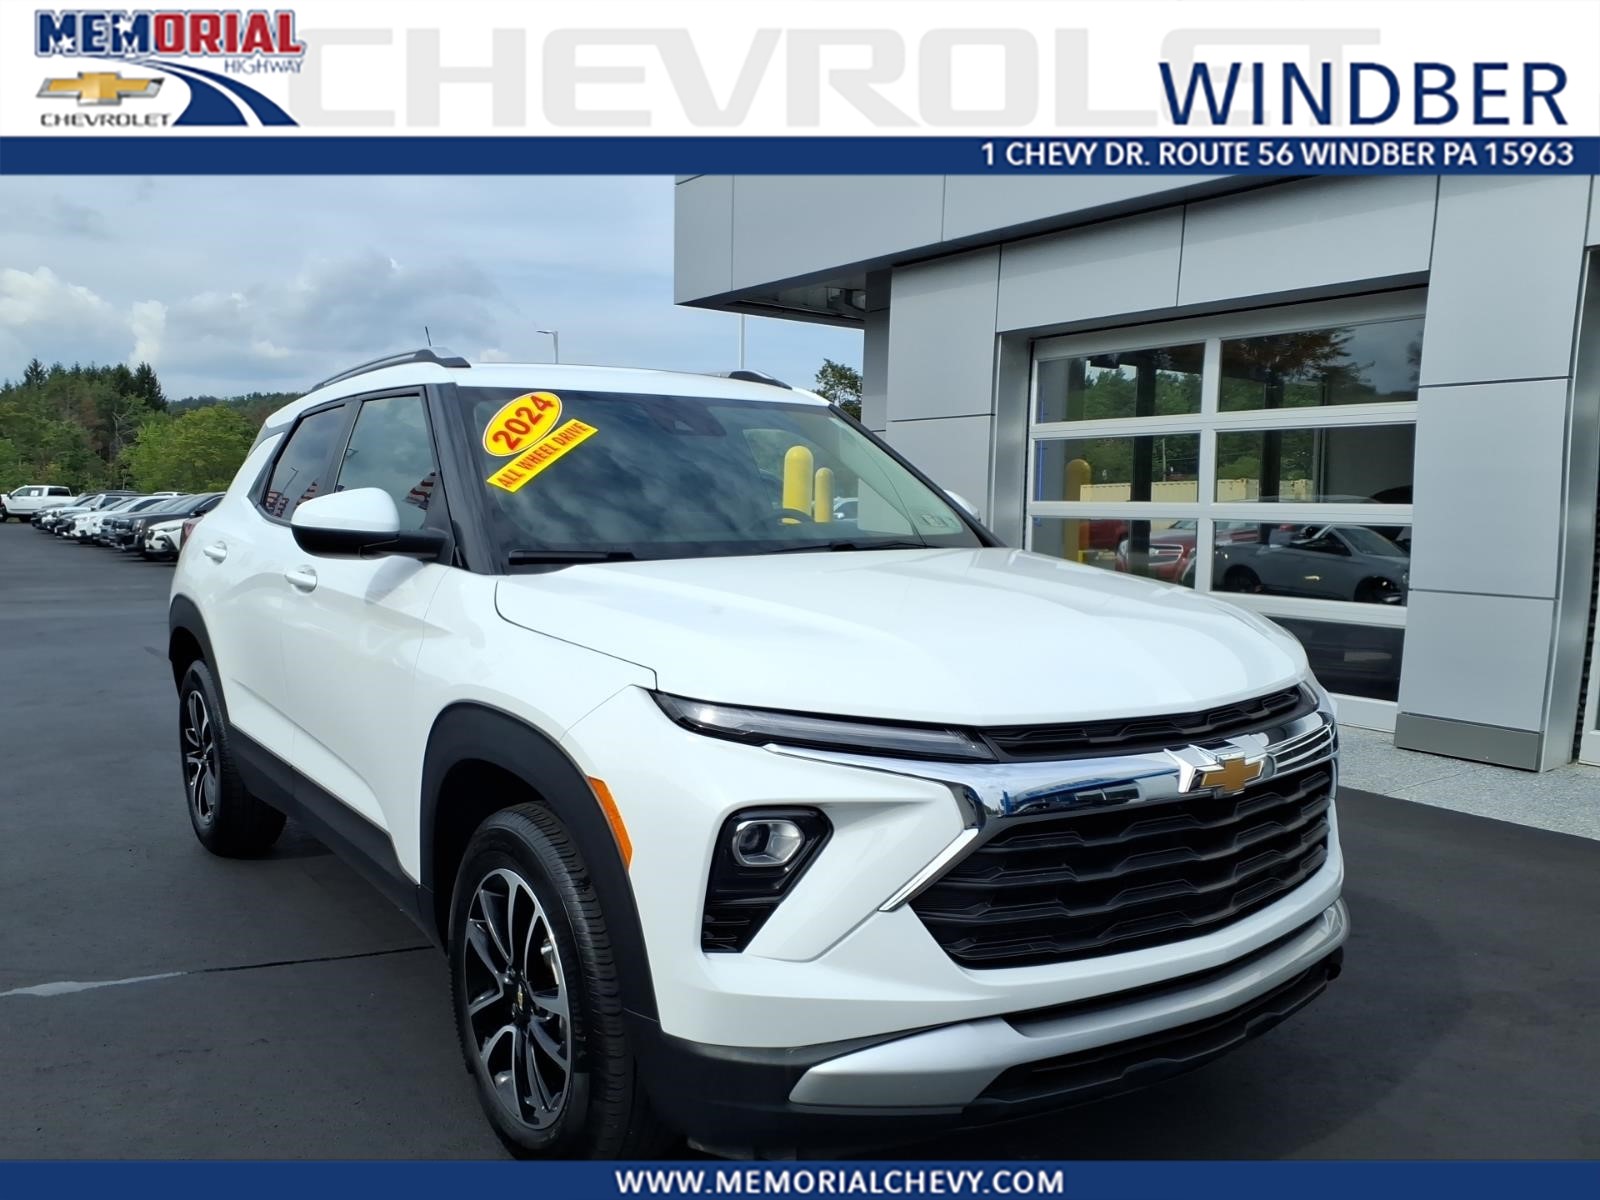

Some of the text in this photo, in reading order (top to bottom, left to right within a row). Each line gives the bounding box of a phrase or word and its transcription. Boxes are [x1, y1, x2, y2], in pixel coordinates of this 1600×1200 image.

[492, 394, 554, 451] 2024
[497, 422, 589, 488] ALL WHEEL DRIVE
